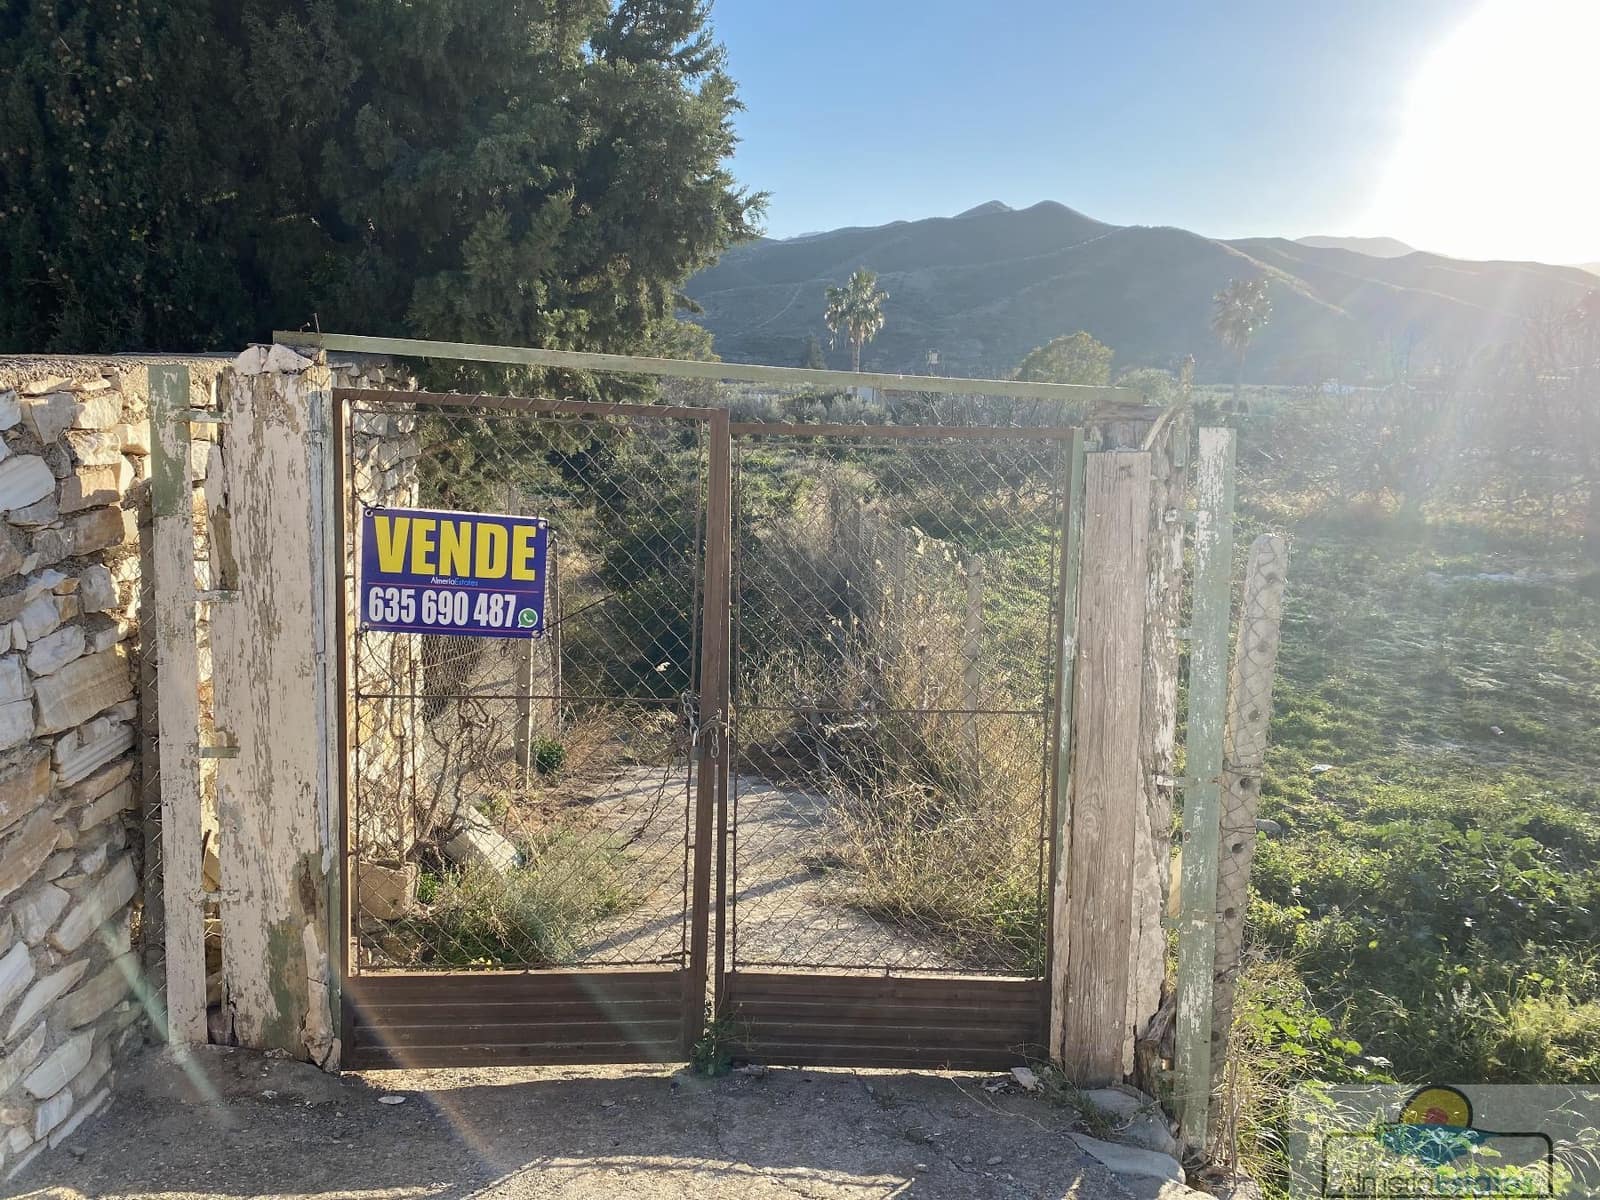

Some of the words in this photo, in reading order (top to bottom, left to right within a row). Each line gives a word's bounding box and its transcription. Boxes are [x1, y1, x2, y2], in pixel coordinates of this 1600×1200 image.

[374, 515, 536, 581] VENDE
[368, 586, 416, 624] 635
[421, 589, 470, 626] 690
[473, 592, 517, 627] 487
